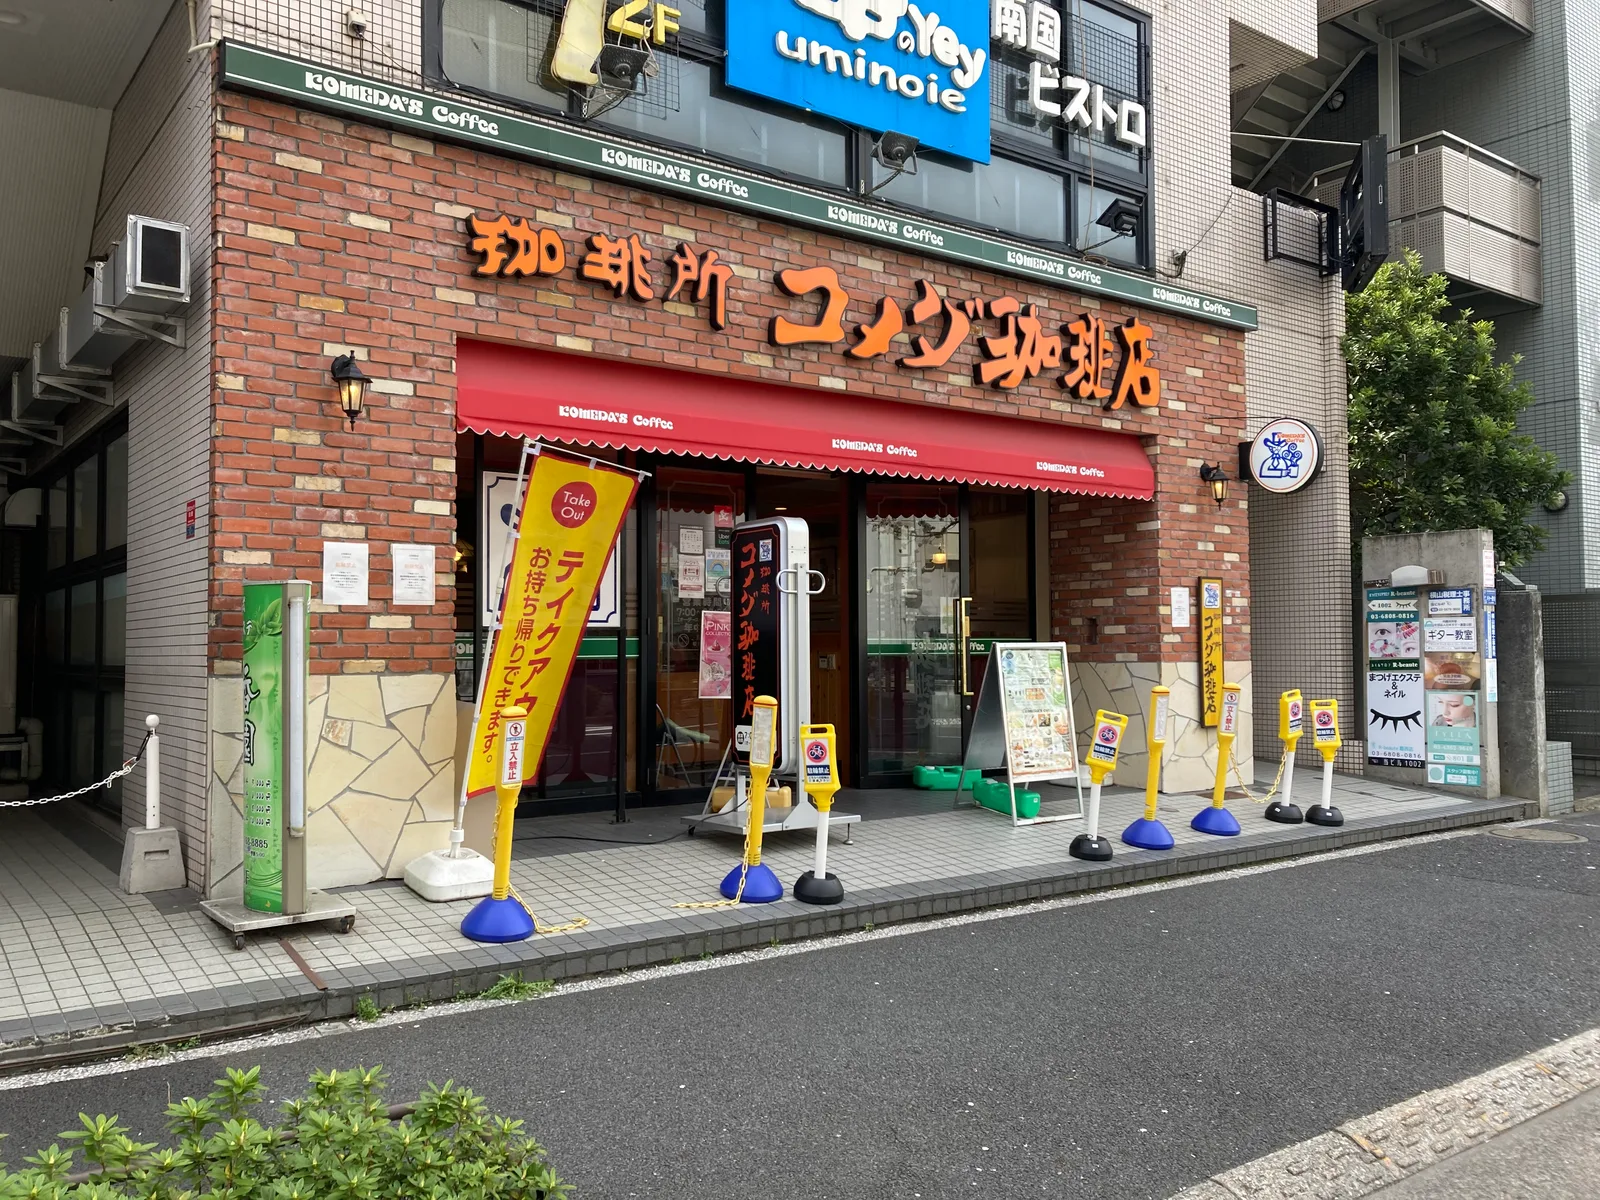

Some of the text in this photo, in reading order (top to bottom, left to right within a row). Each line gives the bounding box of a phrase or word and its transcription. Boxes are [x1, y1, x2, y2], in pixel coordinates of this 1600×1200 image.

[991, 0, 1061, 62] 南国
[775, 30, 967, 114] uminoie
[304, 71, 499, 136] KOMEDA'S Coffee
[1029, 61, 1146, 147] ビストロ
[601, 147, 748, 198] KOMEDA'S Coffee
[827, 204, 944, 247] KOMEDA'S Coffee
[1006, 250, 1102, 285] KOMEDA'S Coffee
[466, 213, 1162, 411] 珈琲所 コメダ珈琲店
[1152, 287, 1232, 316] KOMEDA'S Coffee
[559, 405, 674, 430] KOMEDA'S Coffee
[832, 438, 918, 458] KOMEDA'S Coffee
[1036, 462, 1104, 477] KOMEDA'S Coffee
[563, 491, 591, 507] Take
[560, 507, 585, 521] Out
[514, 551, 585, 715] テイクアウ
[1428, 629, 1473, 641] ギター教室
[1384, 689, 1407, 698] ネイル
[1391, 681, 1398, 690] &
[1225, 705, 1234, 731] 立入禁止
[507, 741, 519, 781] 立入禁止
[1371, 750, 1422, 759] 03-6808-0816
[1405, 760, 1422, 768] 1002
